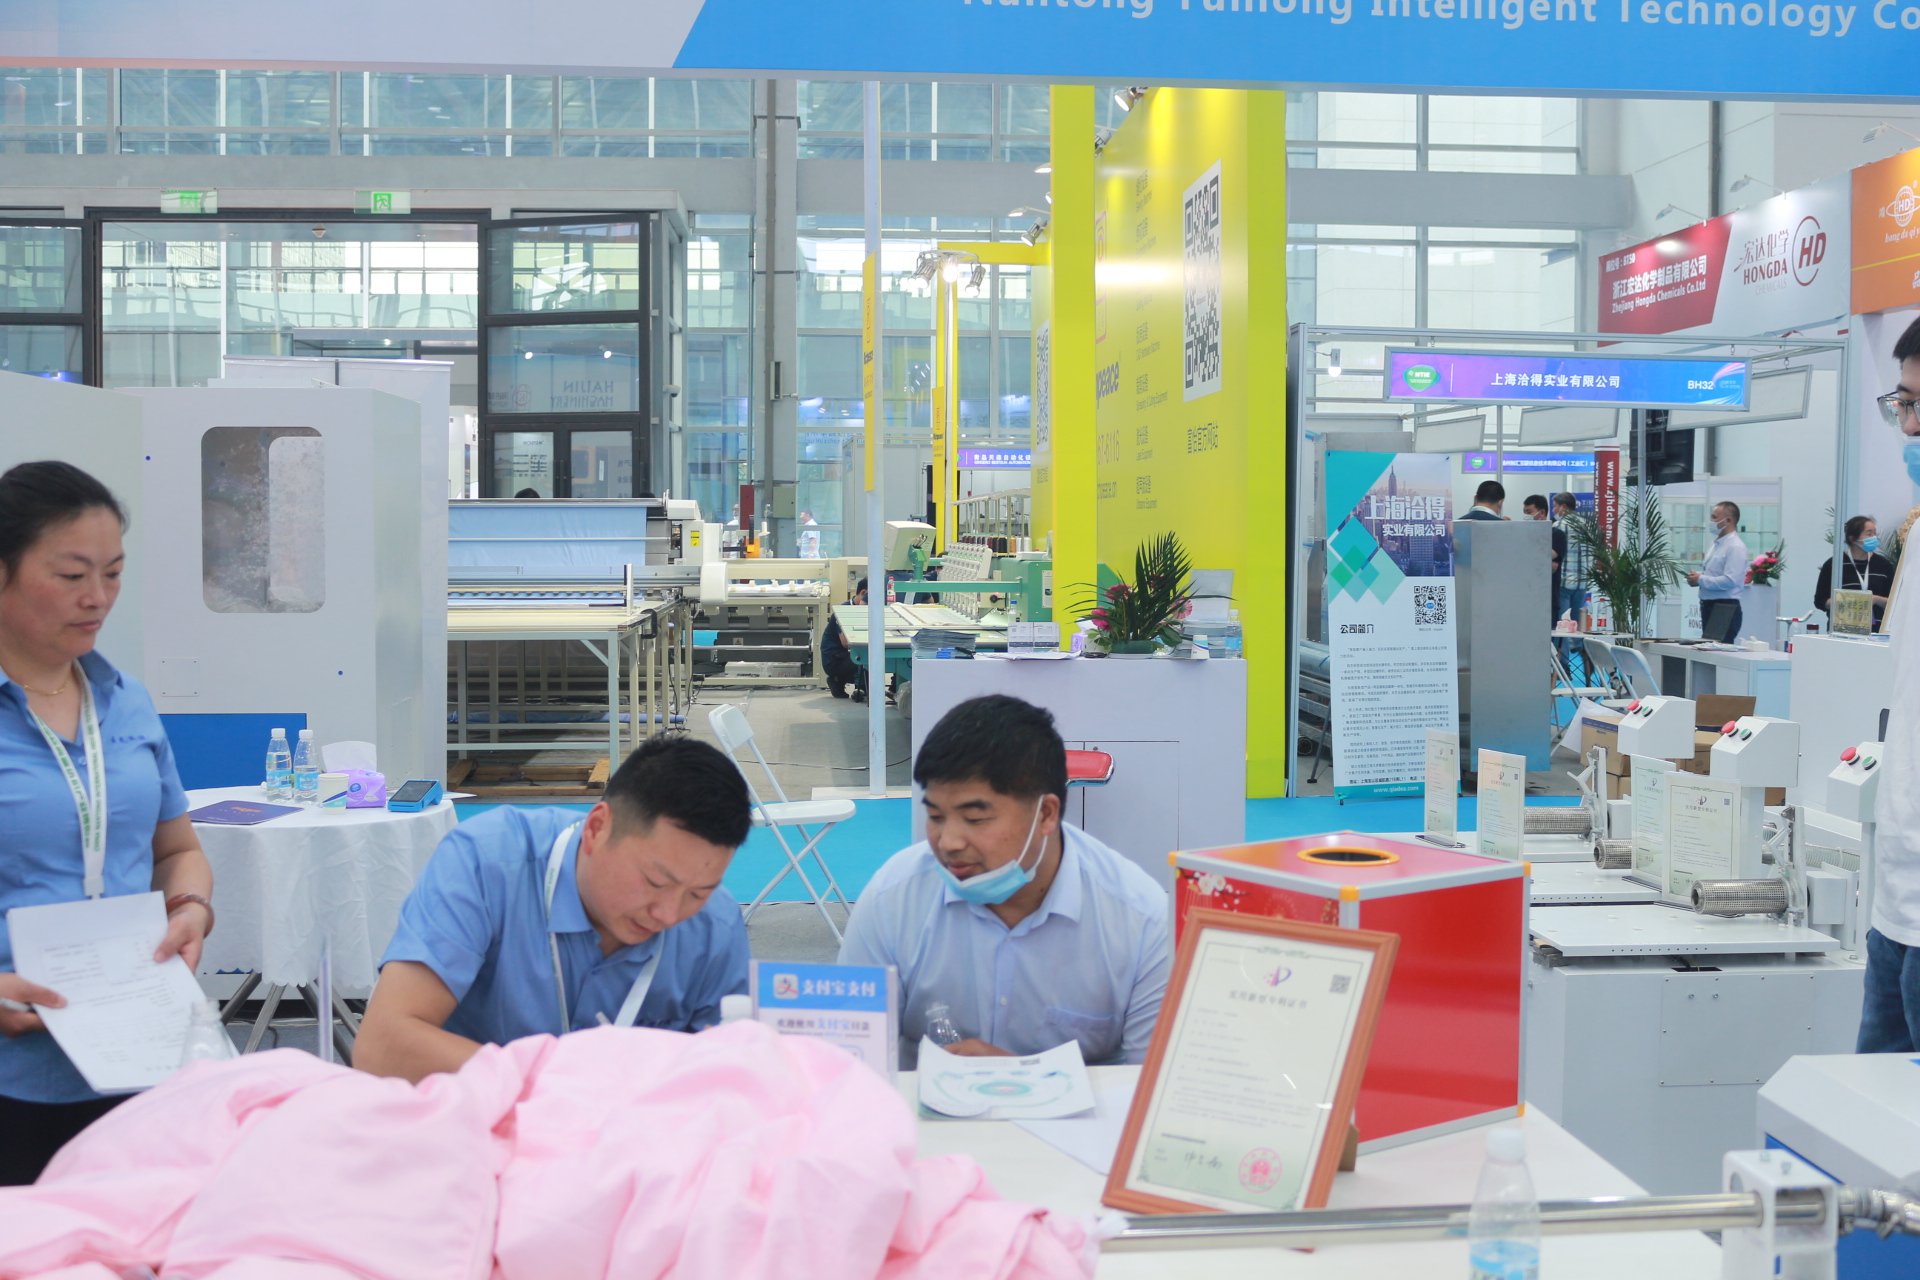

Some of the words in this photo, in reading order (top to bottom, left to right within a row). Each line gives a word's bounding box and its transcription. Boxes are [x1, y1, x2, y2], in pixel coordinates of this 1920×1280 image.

[1798, 232, 1827, 270] HD
[1612, 254, 1708, 300] 浙江宏达化学制品有限公司
[1743, 258, 1788, 285] HONGDA
[1755, 277, 1787, 295] CHEMICALS
[1612, 299, 1634, 314] Zhejiang
[1635, 292, 1656, 307] Hongda
[1657, 284, 1686, 302] Chemicals
[1490, 372, 1622, 390] 上海洽得实业有限公司
[1687, 380, 1714, 390] BH32
[1364, 495, 1446, 521] 上海洽得
[1382, 523, 1446, 537] 实业有限公司
[1340, 623, 1375, 634] 公司简介
[802, 979, 876, 997] 支付宝支付
